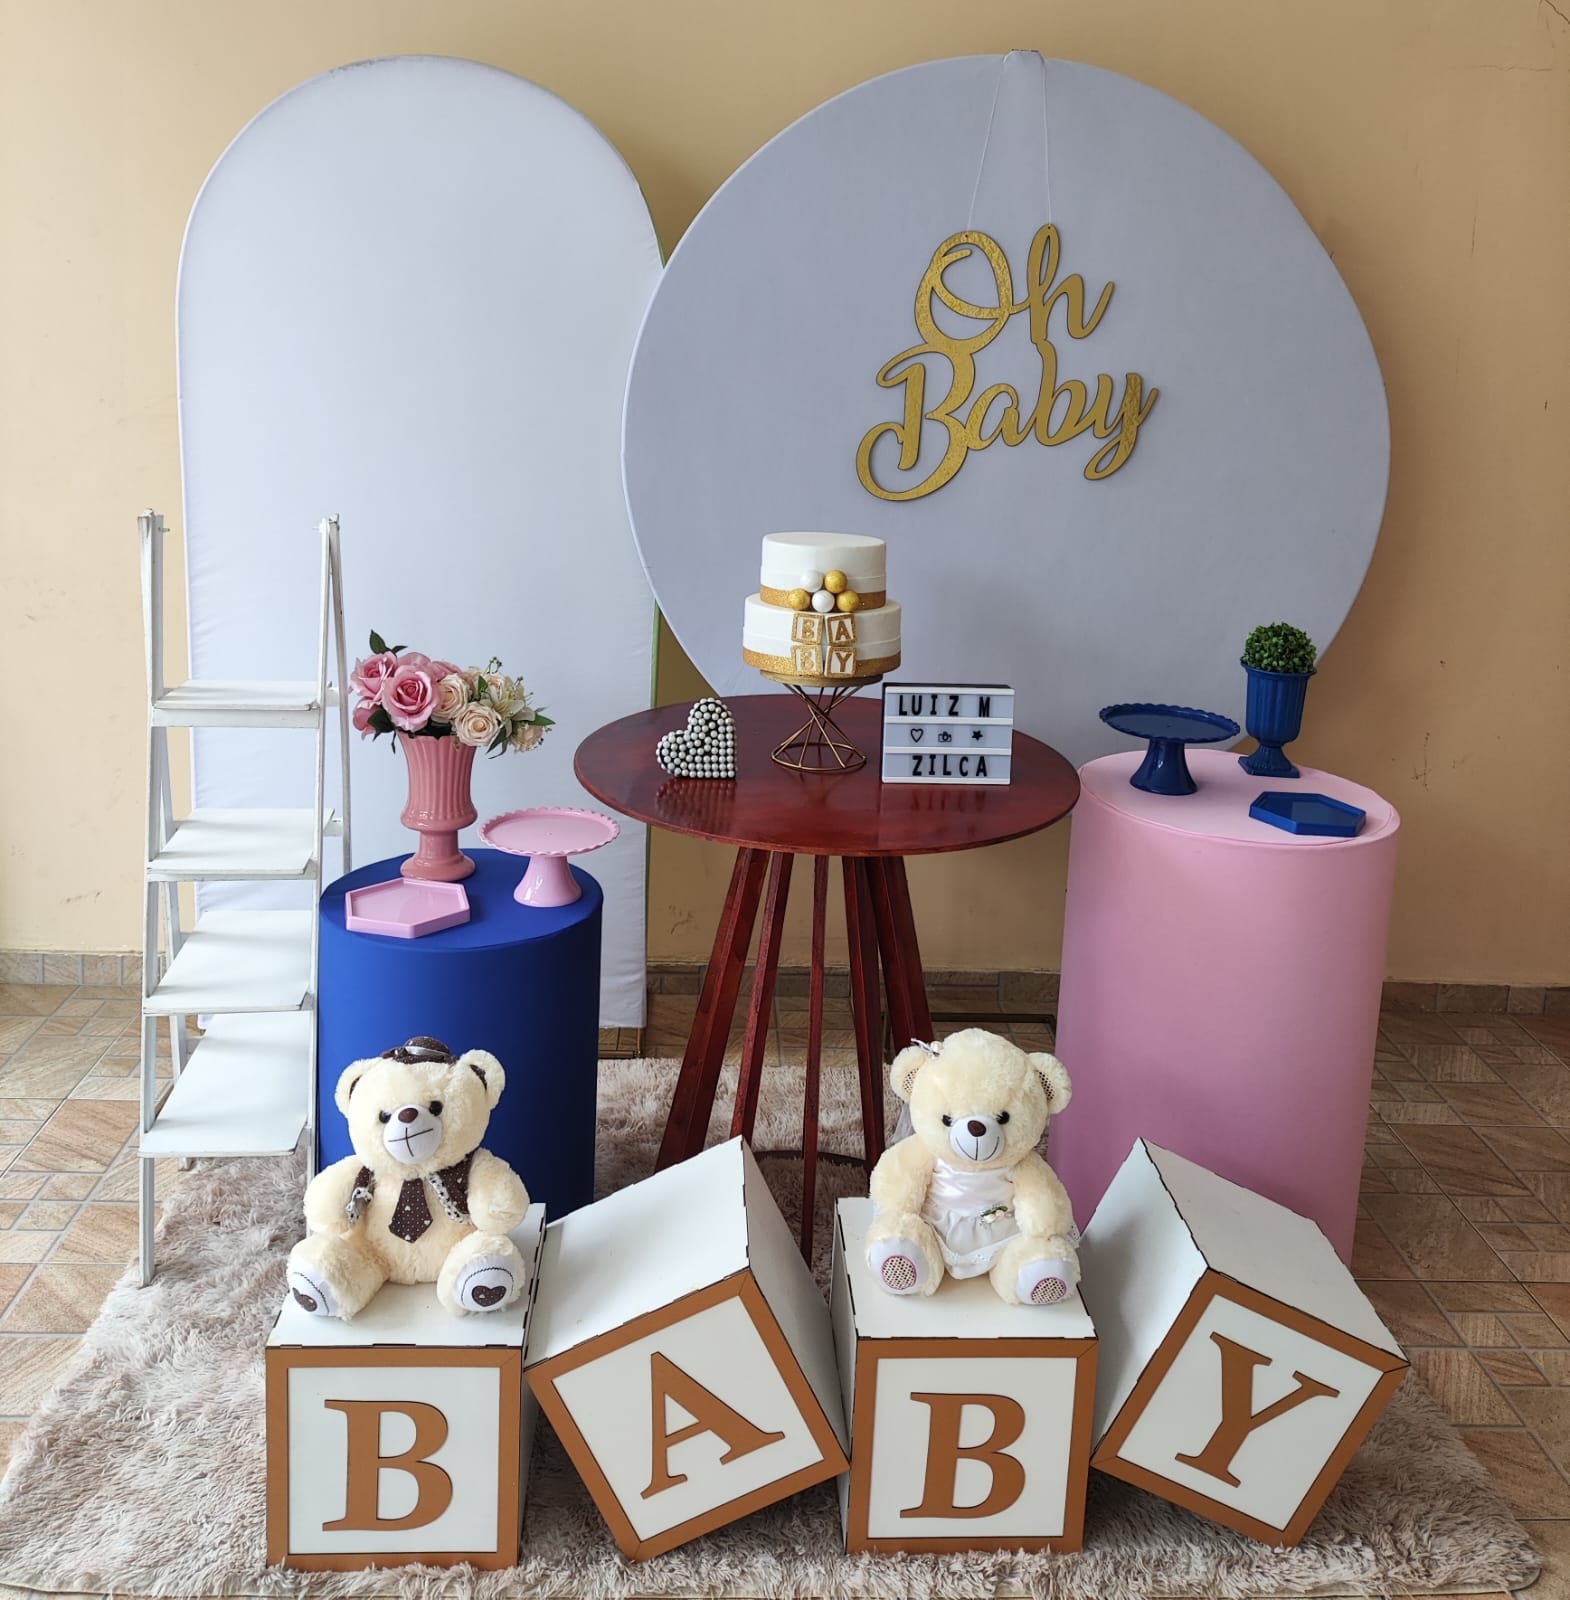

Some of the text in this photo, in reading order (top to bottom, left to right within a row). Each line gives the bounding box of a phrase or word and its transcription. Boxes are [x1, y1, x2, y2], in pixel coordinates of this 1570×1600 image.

[914, 223, 1115, 351] Oh
[856, 339, 1159, 501] Baby
[899, 694, 990, 717] LUIZ M
[912, 755, 988, 777] ZILCA
